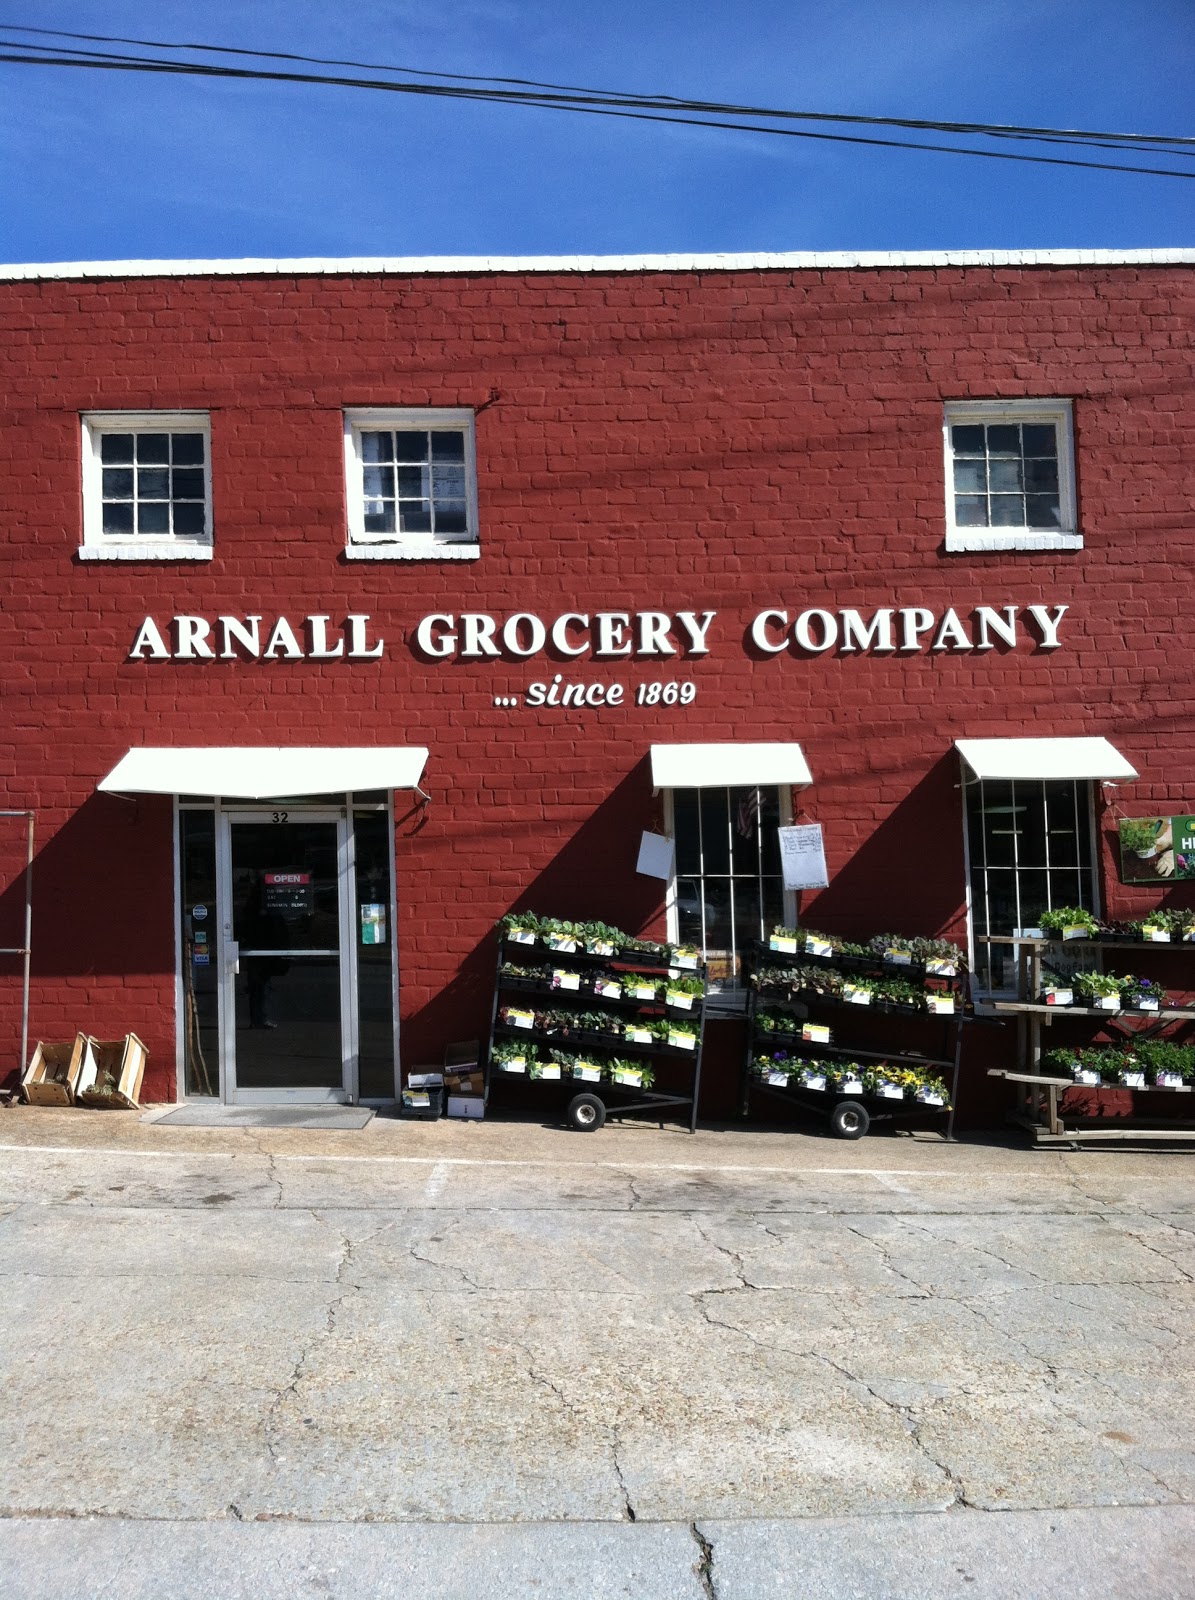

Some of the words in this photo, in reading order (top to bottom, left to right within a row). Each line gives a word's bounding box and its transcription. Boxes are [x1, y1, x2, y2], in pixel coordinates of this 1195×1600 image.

[129, 615, 384, 658] ARNALL
[417, 611, 717, 657] GROCERY
[752, 605, 1070, 653] COMPANY
[526, 674, 624, 706] since
[638, 682, 696, 705] 1869
[272, 812, 289, 824] 32
[273, 874, 301, 883] OPEN
